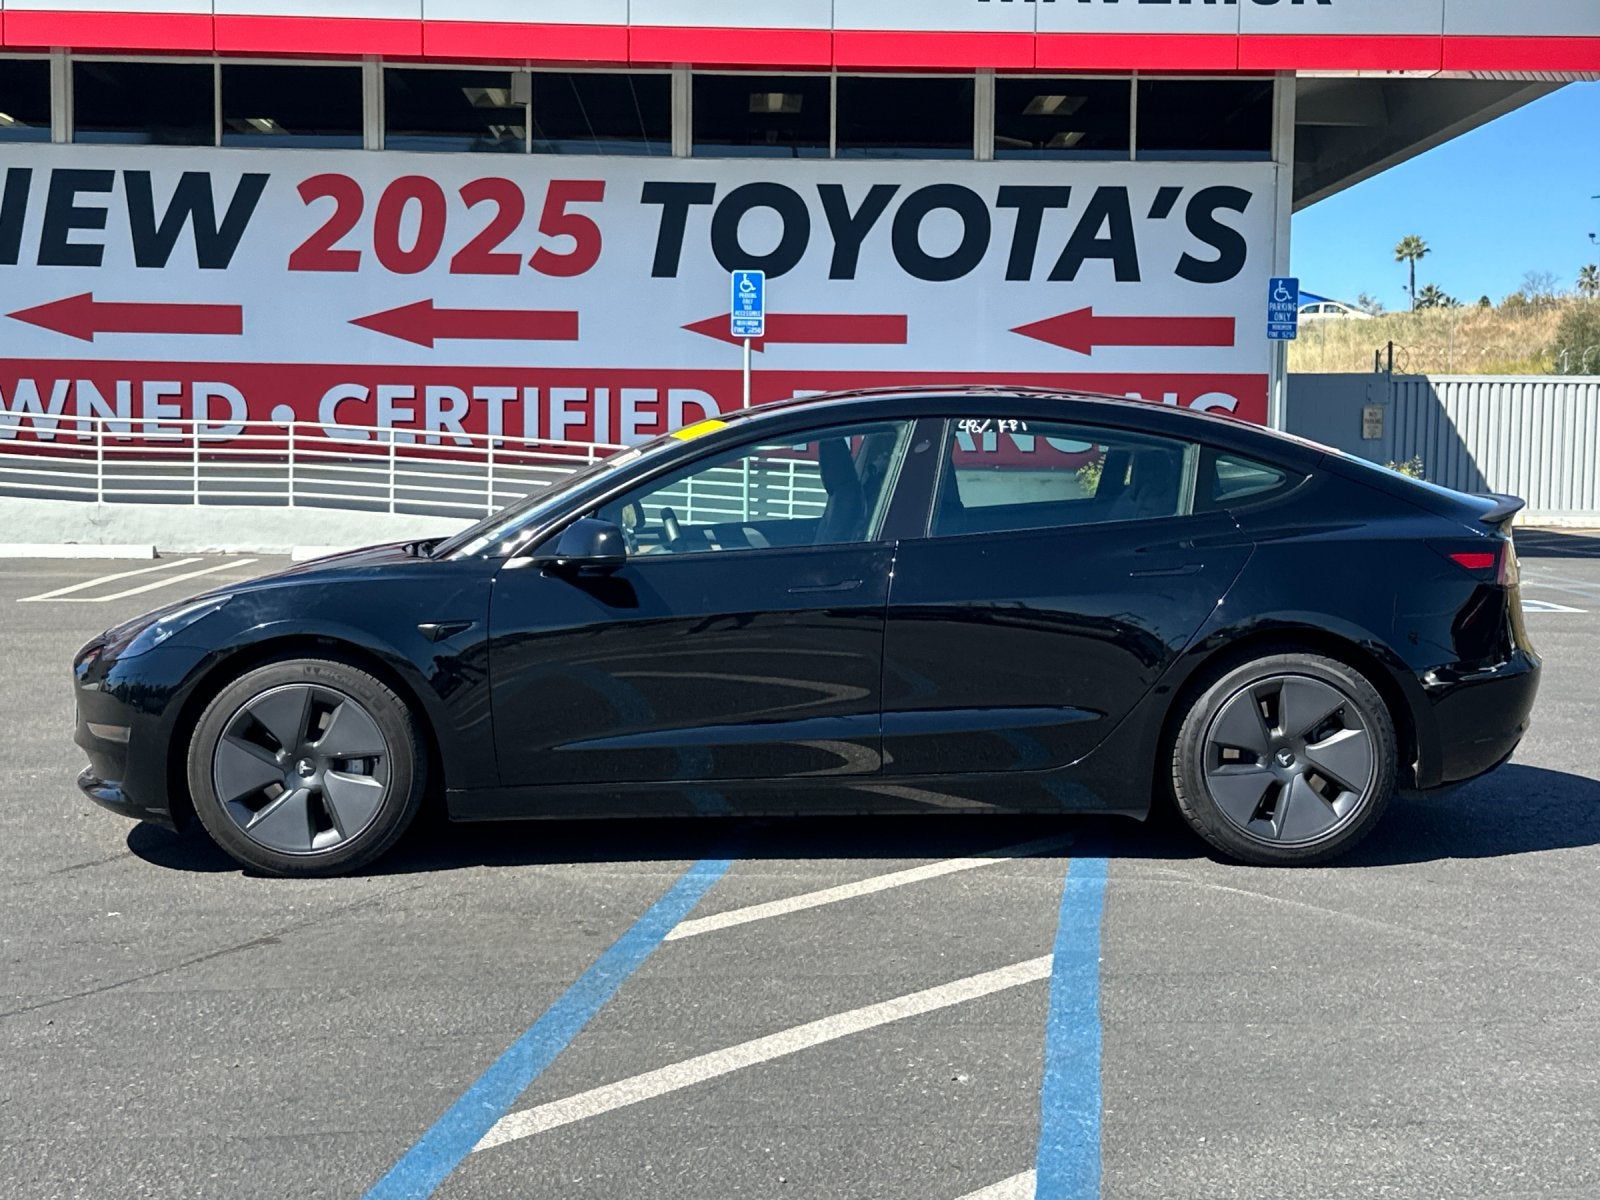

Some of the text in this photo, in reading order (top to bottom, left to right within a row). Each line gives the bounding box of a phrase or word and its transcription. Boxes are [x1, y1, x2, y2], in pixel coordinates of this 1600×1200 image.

[288, 173, 606, 276] 2025
[640, 181, 1253, 284] TOYOTA'S
[1269, 302, 1297, 312] PARKING
[1273, 312, 1292, 321] ONLY
[318, 383, 722, 447] CERTIFIED
